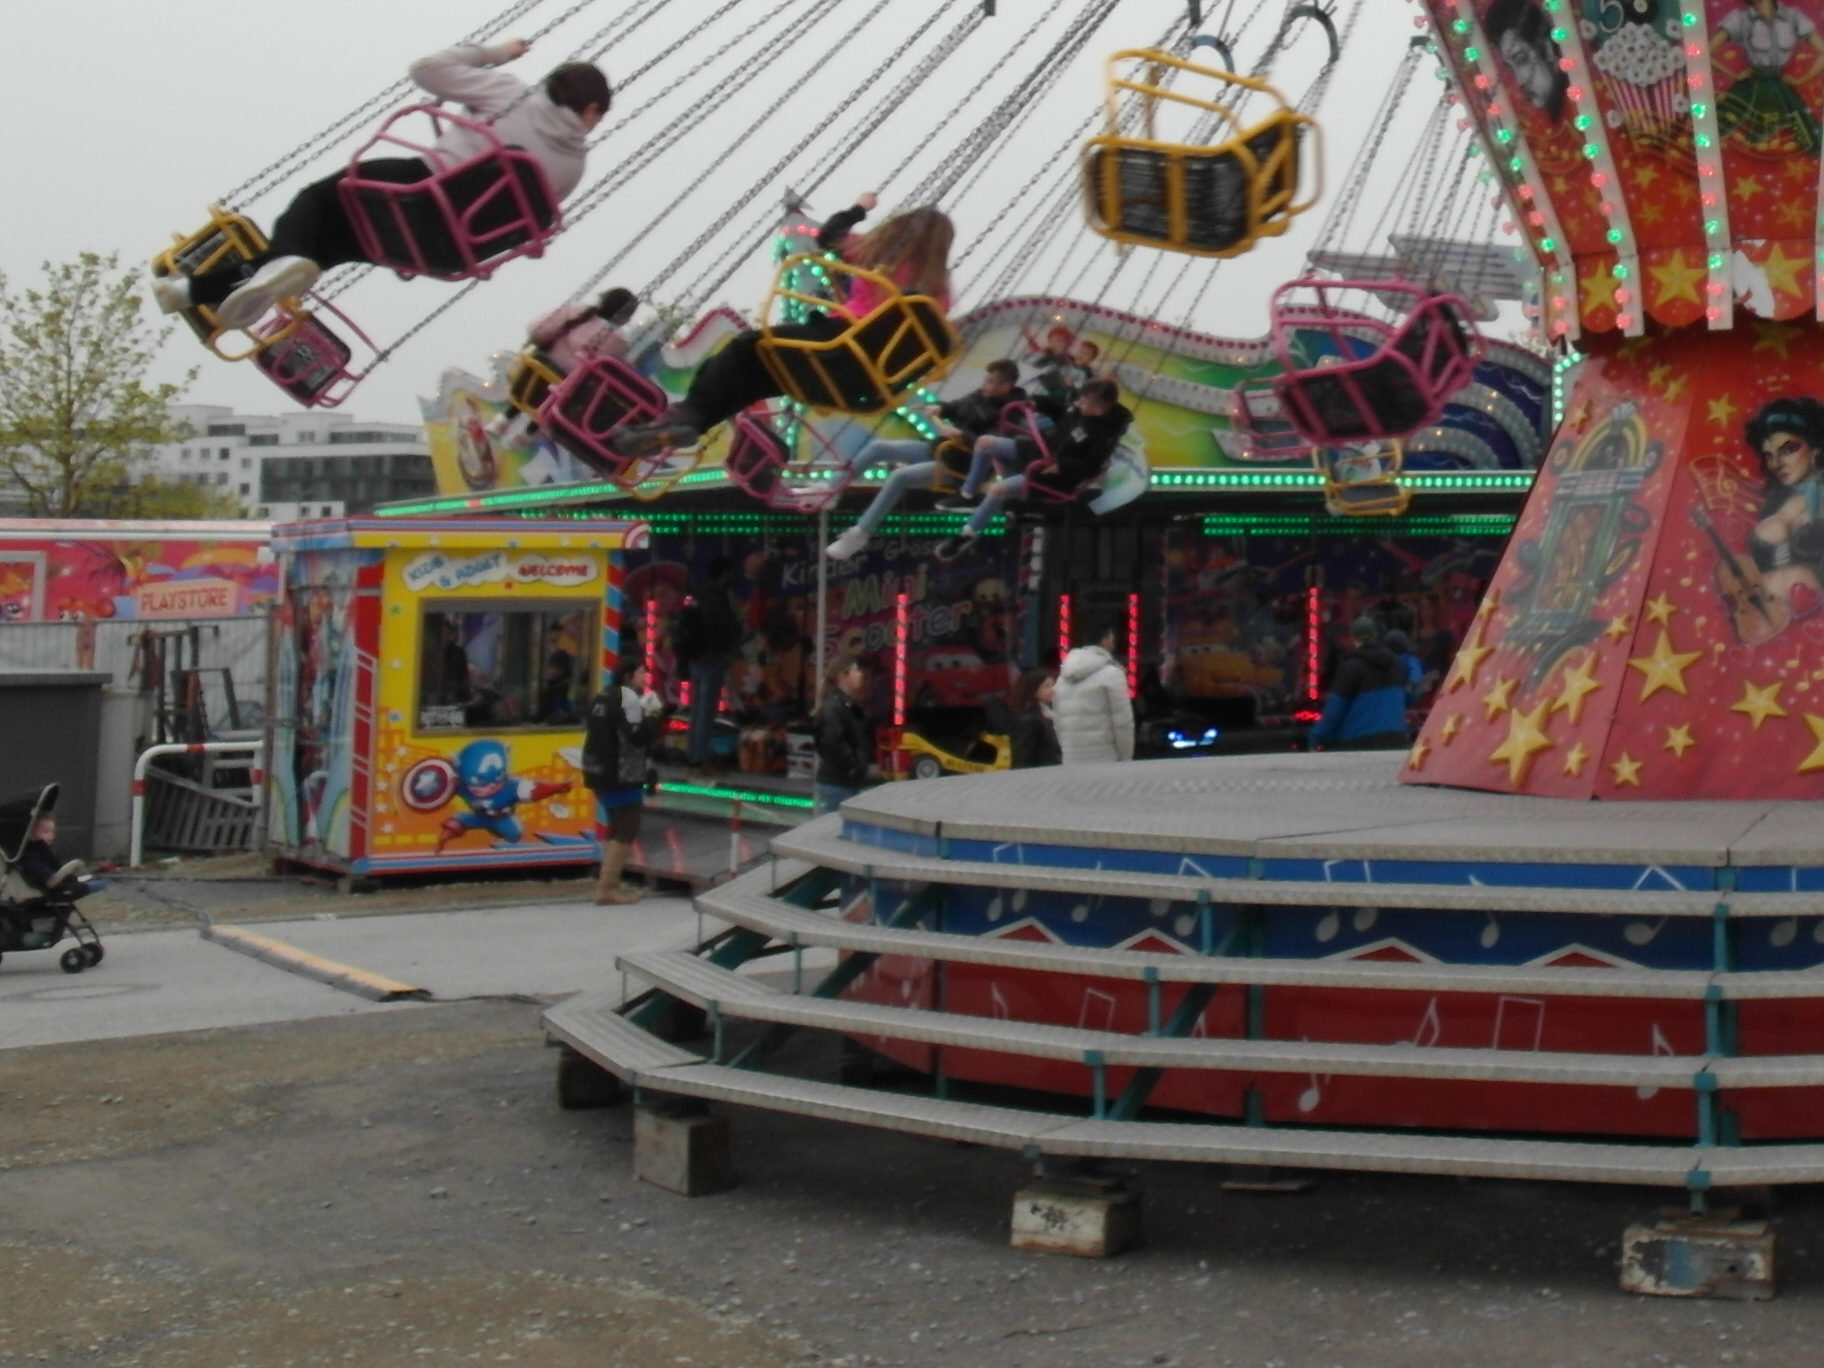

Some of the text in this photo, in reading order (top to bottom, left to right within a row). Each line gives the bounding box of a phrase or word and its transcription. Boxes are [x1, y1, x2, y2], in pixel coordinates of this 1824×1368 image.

[518, 564, 588, 577] WELCOME
[141, 587, 228, 613] PLAYSTORE
[841, 563, 928, 621] Mini
